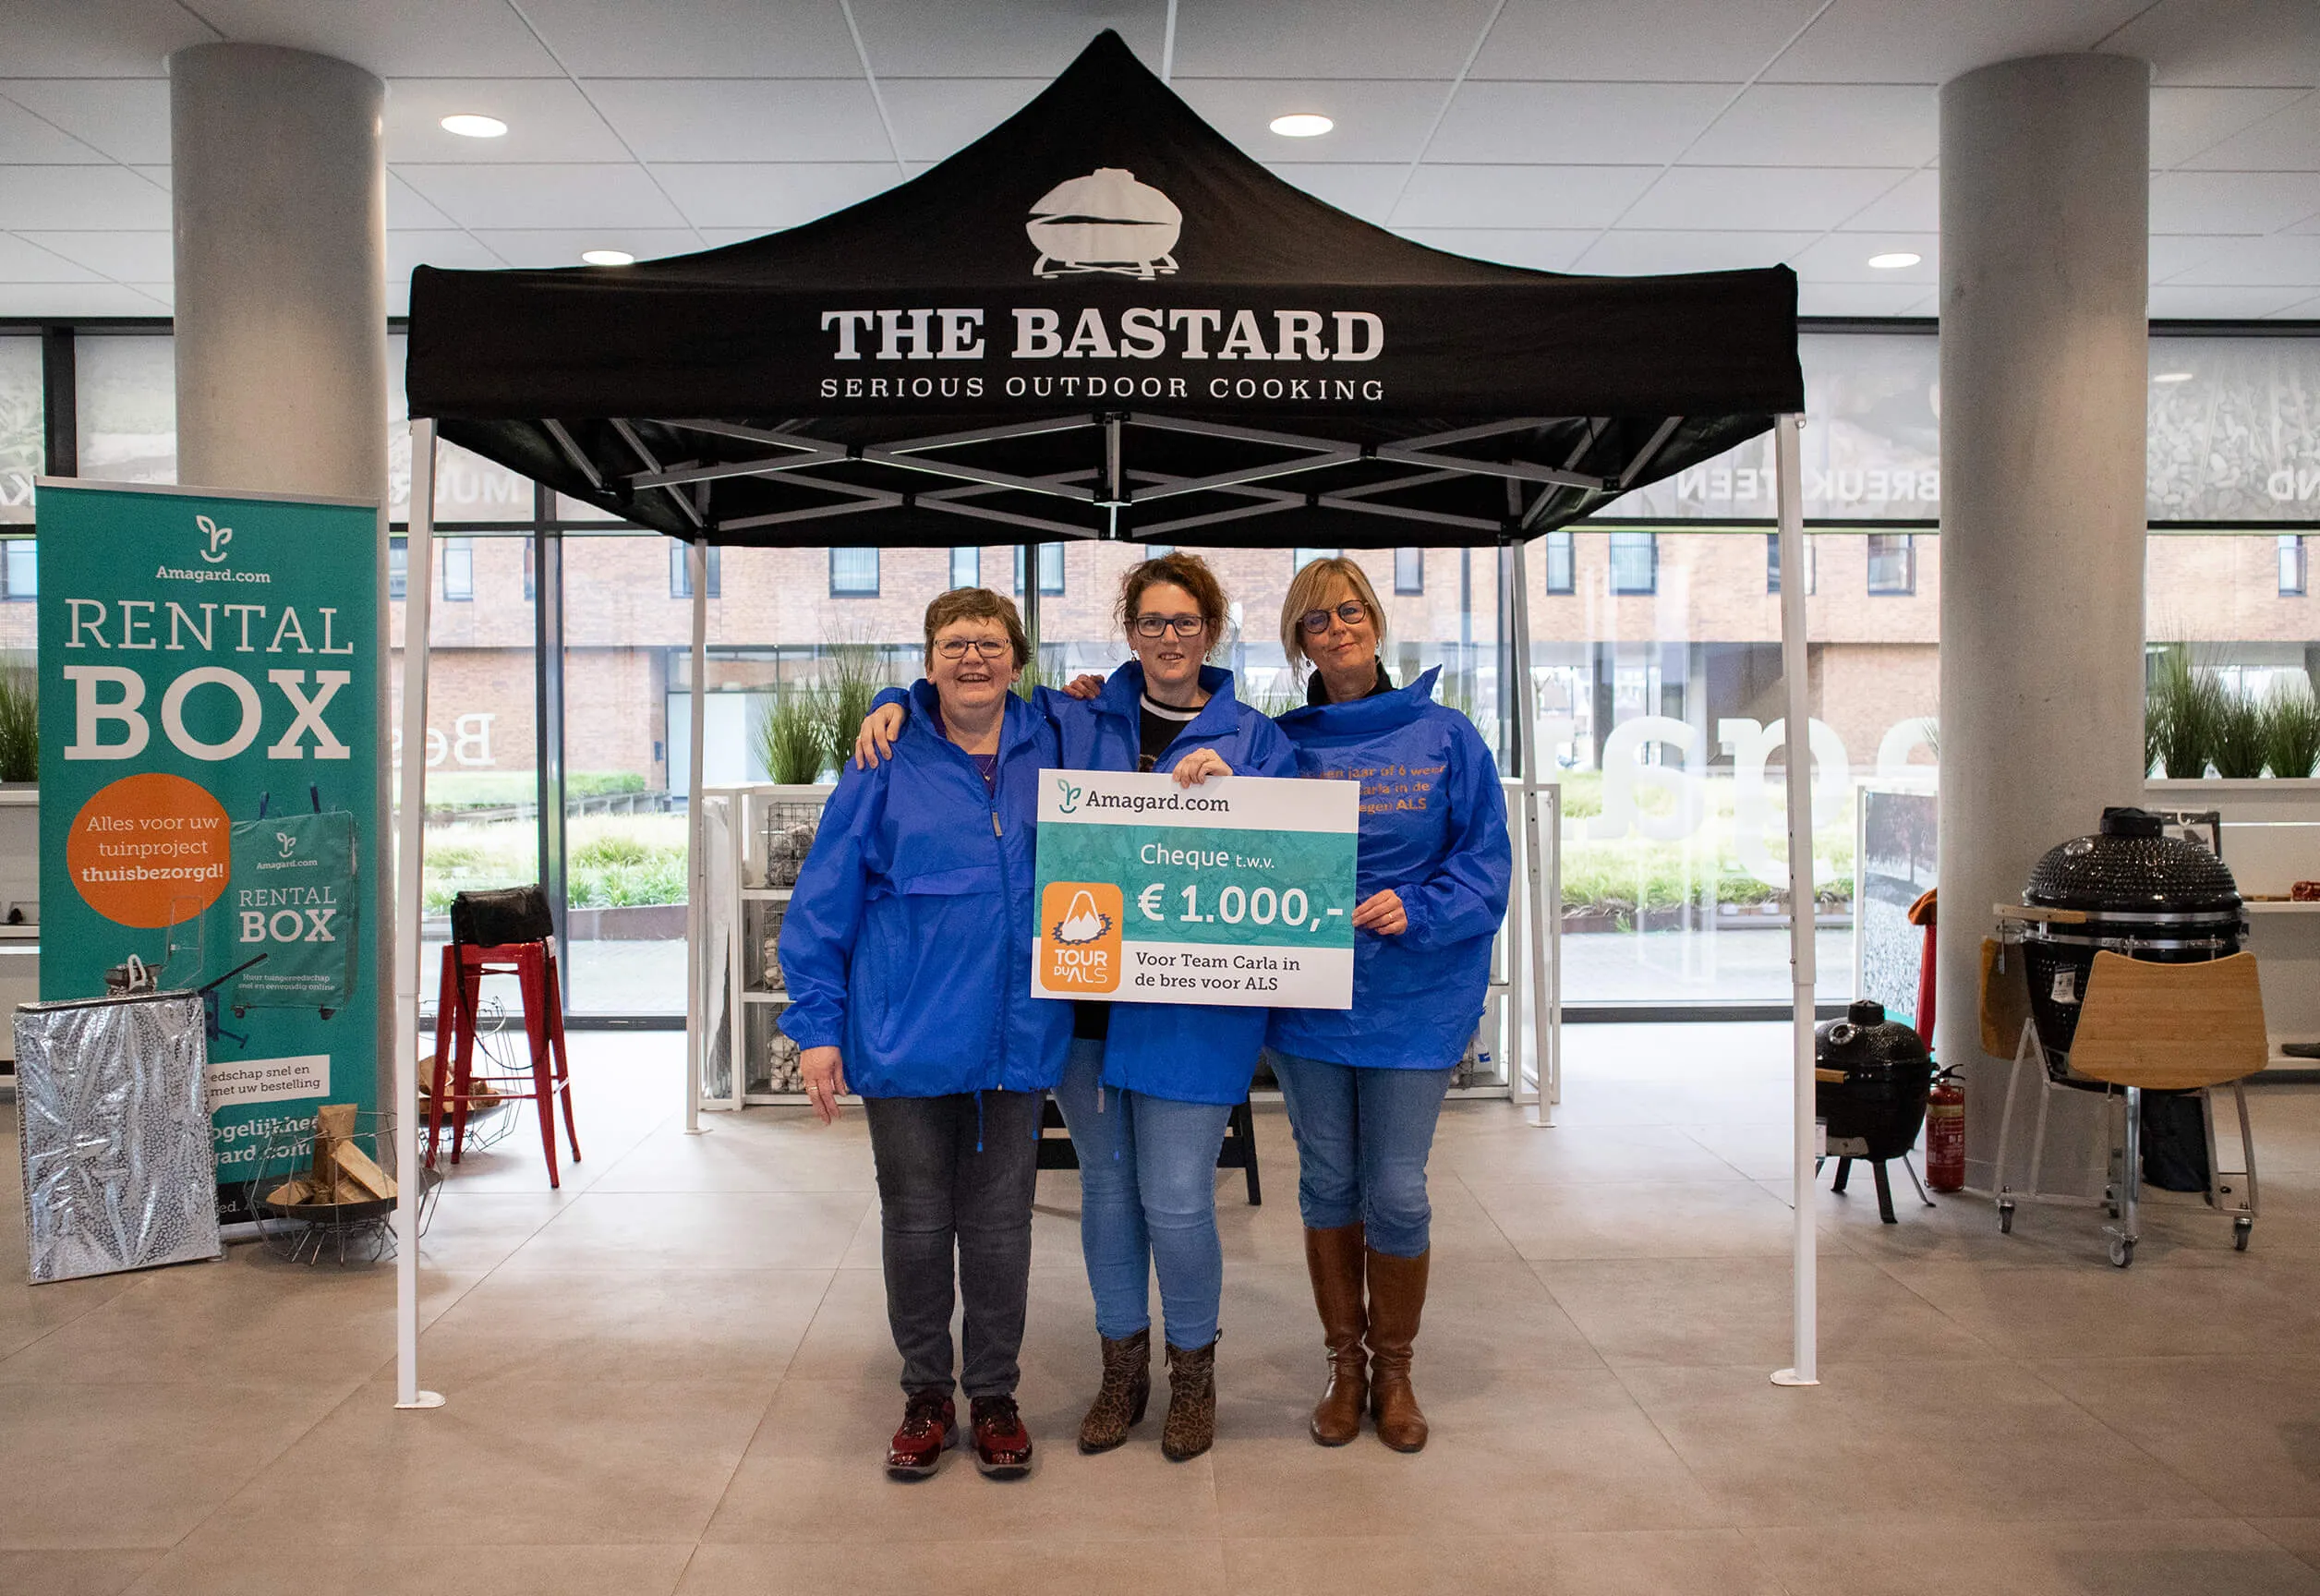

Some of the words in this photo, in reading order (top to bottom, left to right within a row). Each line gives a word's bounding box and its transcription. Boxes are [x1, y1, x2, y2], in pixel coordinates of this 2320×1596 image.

[821, 308, 985, 360] THE
[1011, 308, 1384, 362] BASTARD
[820, 377, 985, 398] SERIOUS
[1006, 377, 1188, 398] OUTDOOR
[1210, 378, 1384, 401] COOKING
[155, 565, 272, 584] Amagard.com
[65, 598, 354, 655] RENTAL
[64, 665, 351, 761] BOX
[1348, 766, 1376, 780] jaar
[1381, 764, 1395, 777] of
[1398, 766, 1406, 777] 6
[1359, 783, 1389, 795] arla
[1395, 782, 1408, 793] in
[1412, 782, 1431, 792] de
[1085, 791, 1230, 813] Amagard.com
[1359, 802, 1394, 815] egen
[1396, 798, 1427, 811] ALS
[86, 816, 135, 832] Alles
[139, 817, 185, 830] voor
[189, 816, 220, 829] uw
[99, 839, 209, 860] tuinproject
[1141, 843, 1229, 870] Cheque
[1236, 855, 1275, 868] t.w.v.
[81, 863, 225, 884] thuisbezorgd!
[256, 859, 318, 871] Amagard.com
[238, 886, 337, 907] RENTAL
[1138, 883, 1165, 922] €
[1180, 885, 1344, 932] 1.000,-
[239, 909, 337, 943] BOX
[1055, 949, 1108, 966] TOUR
[1136, 951, 1177, 967] Voor
[1181, 953, 1227, 969] Team
[1233, 955, 1277, 971] Carla
[1283, 958, 1300, 971] in
[1054, 966, 1069, 976] DU
[1068, 967, 1108, 985] ALS
[1135, 973, 1155, 986] de
[1160, 973, 1197, 988] bres
[1202, 977, 1240, 990] voor
[1244, 976, 1278, 991] ALS
[308, 983, 335, 991] online
[211, 1069, 263, 1082] edschap
[266, 1065, 292, 1078] snel
[294, 1064, 310, 1075] en
[210, 1086, 236, 1097] met
[238, 1084, 258, 1094] uw
[260, 1077, 320, 1093] bestelling
[211, 1115, 319, 1143] ogelijkhe
[214, 1143, 311, 1167] ard.com
[219, 1201, 241, 1214] ed.
